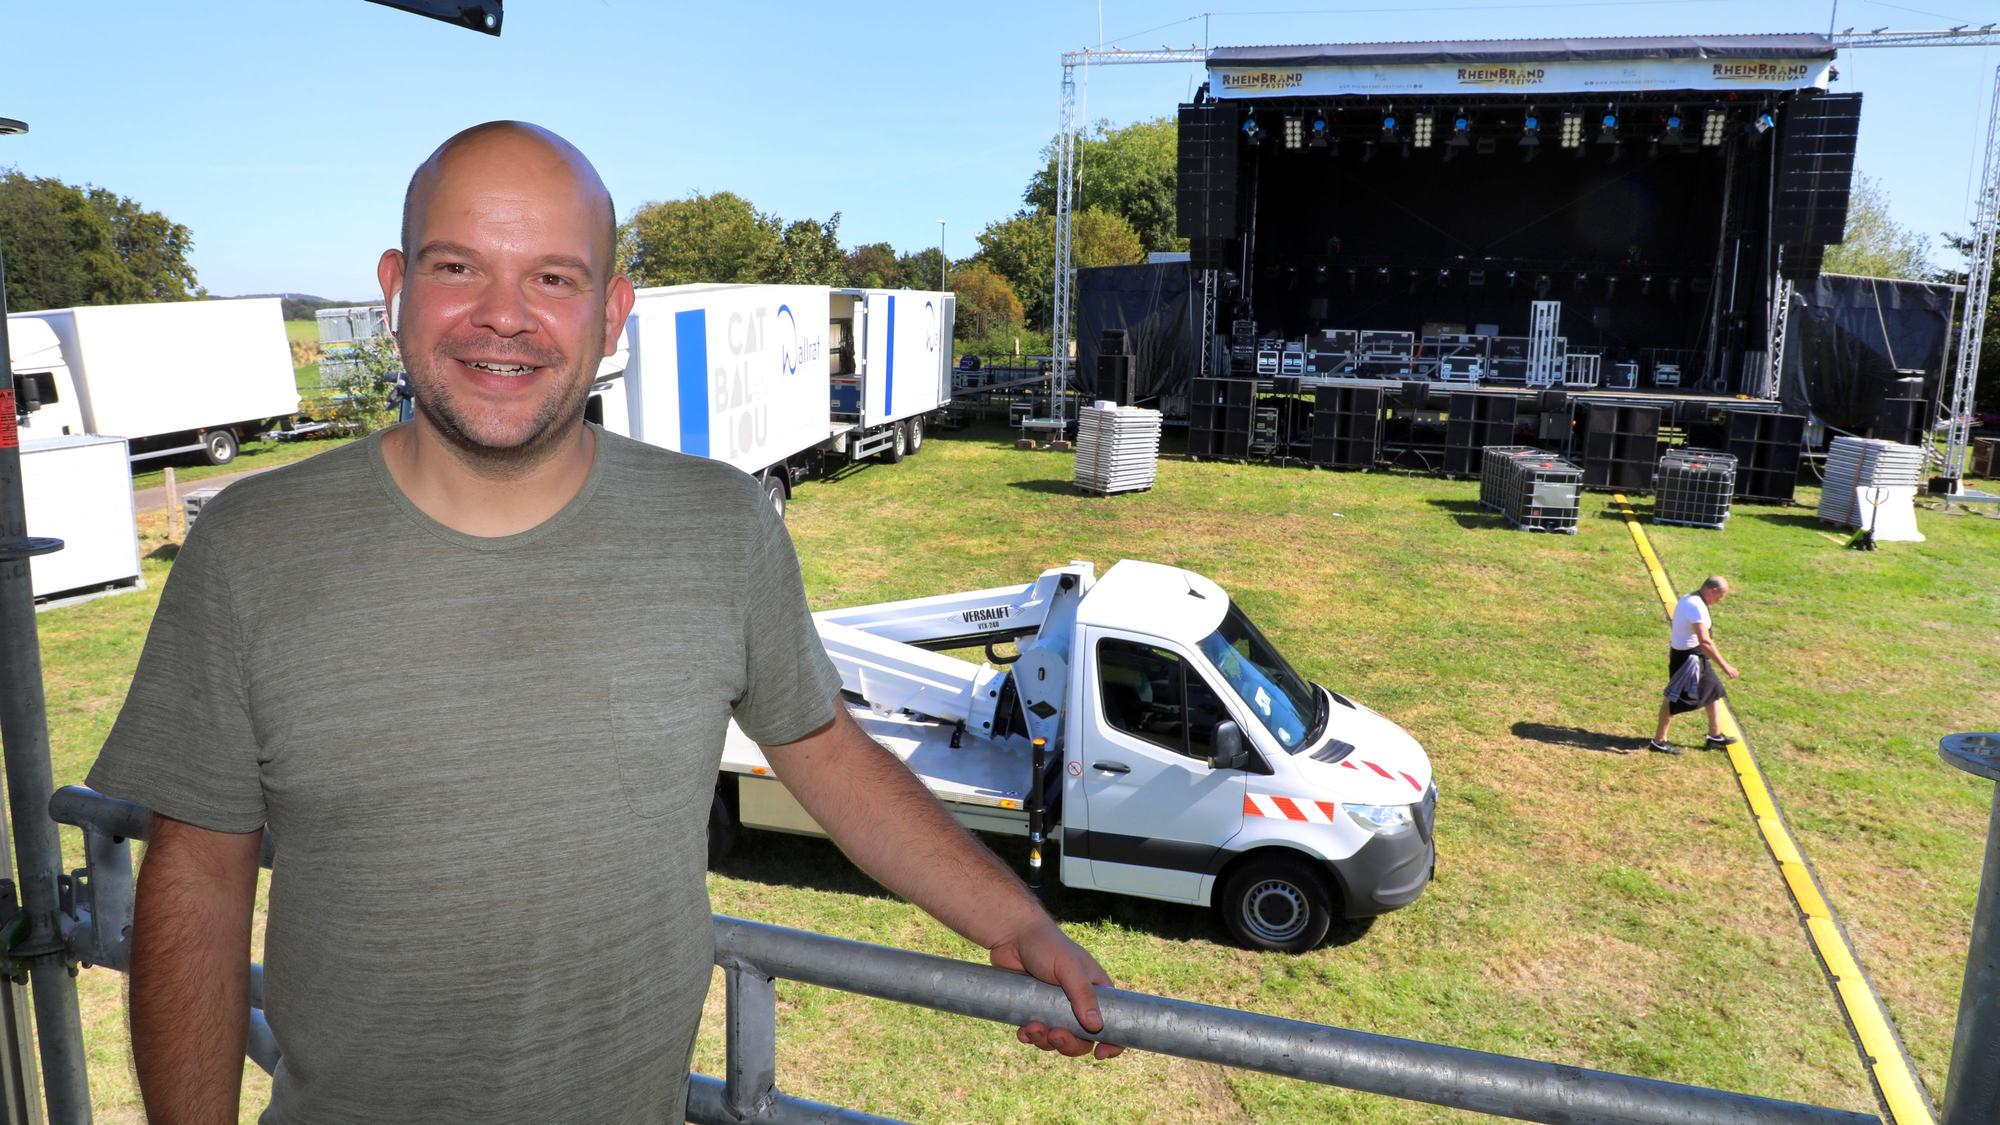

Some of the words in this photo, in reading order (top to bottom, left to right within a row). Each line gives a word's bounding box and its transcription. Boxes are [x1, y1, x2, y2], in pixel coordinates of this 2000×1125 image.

[727, 307, 767, 356] CAT
[777, 304, 820, 376] Wallraf
[729, 403, 767, 459] LOU
[962, 606, 1009, 622] VERSALIFT
